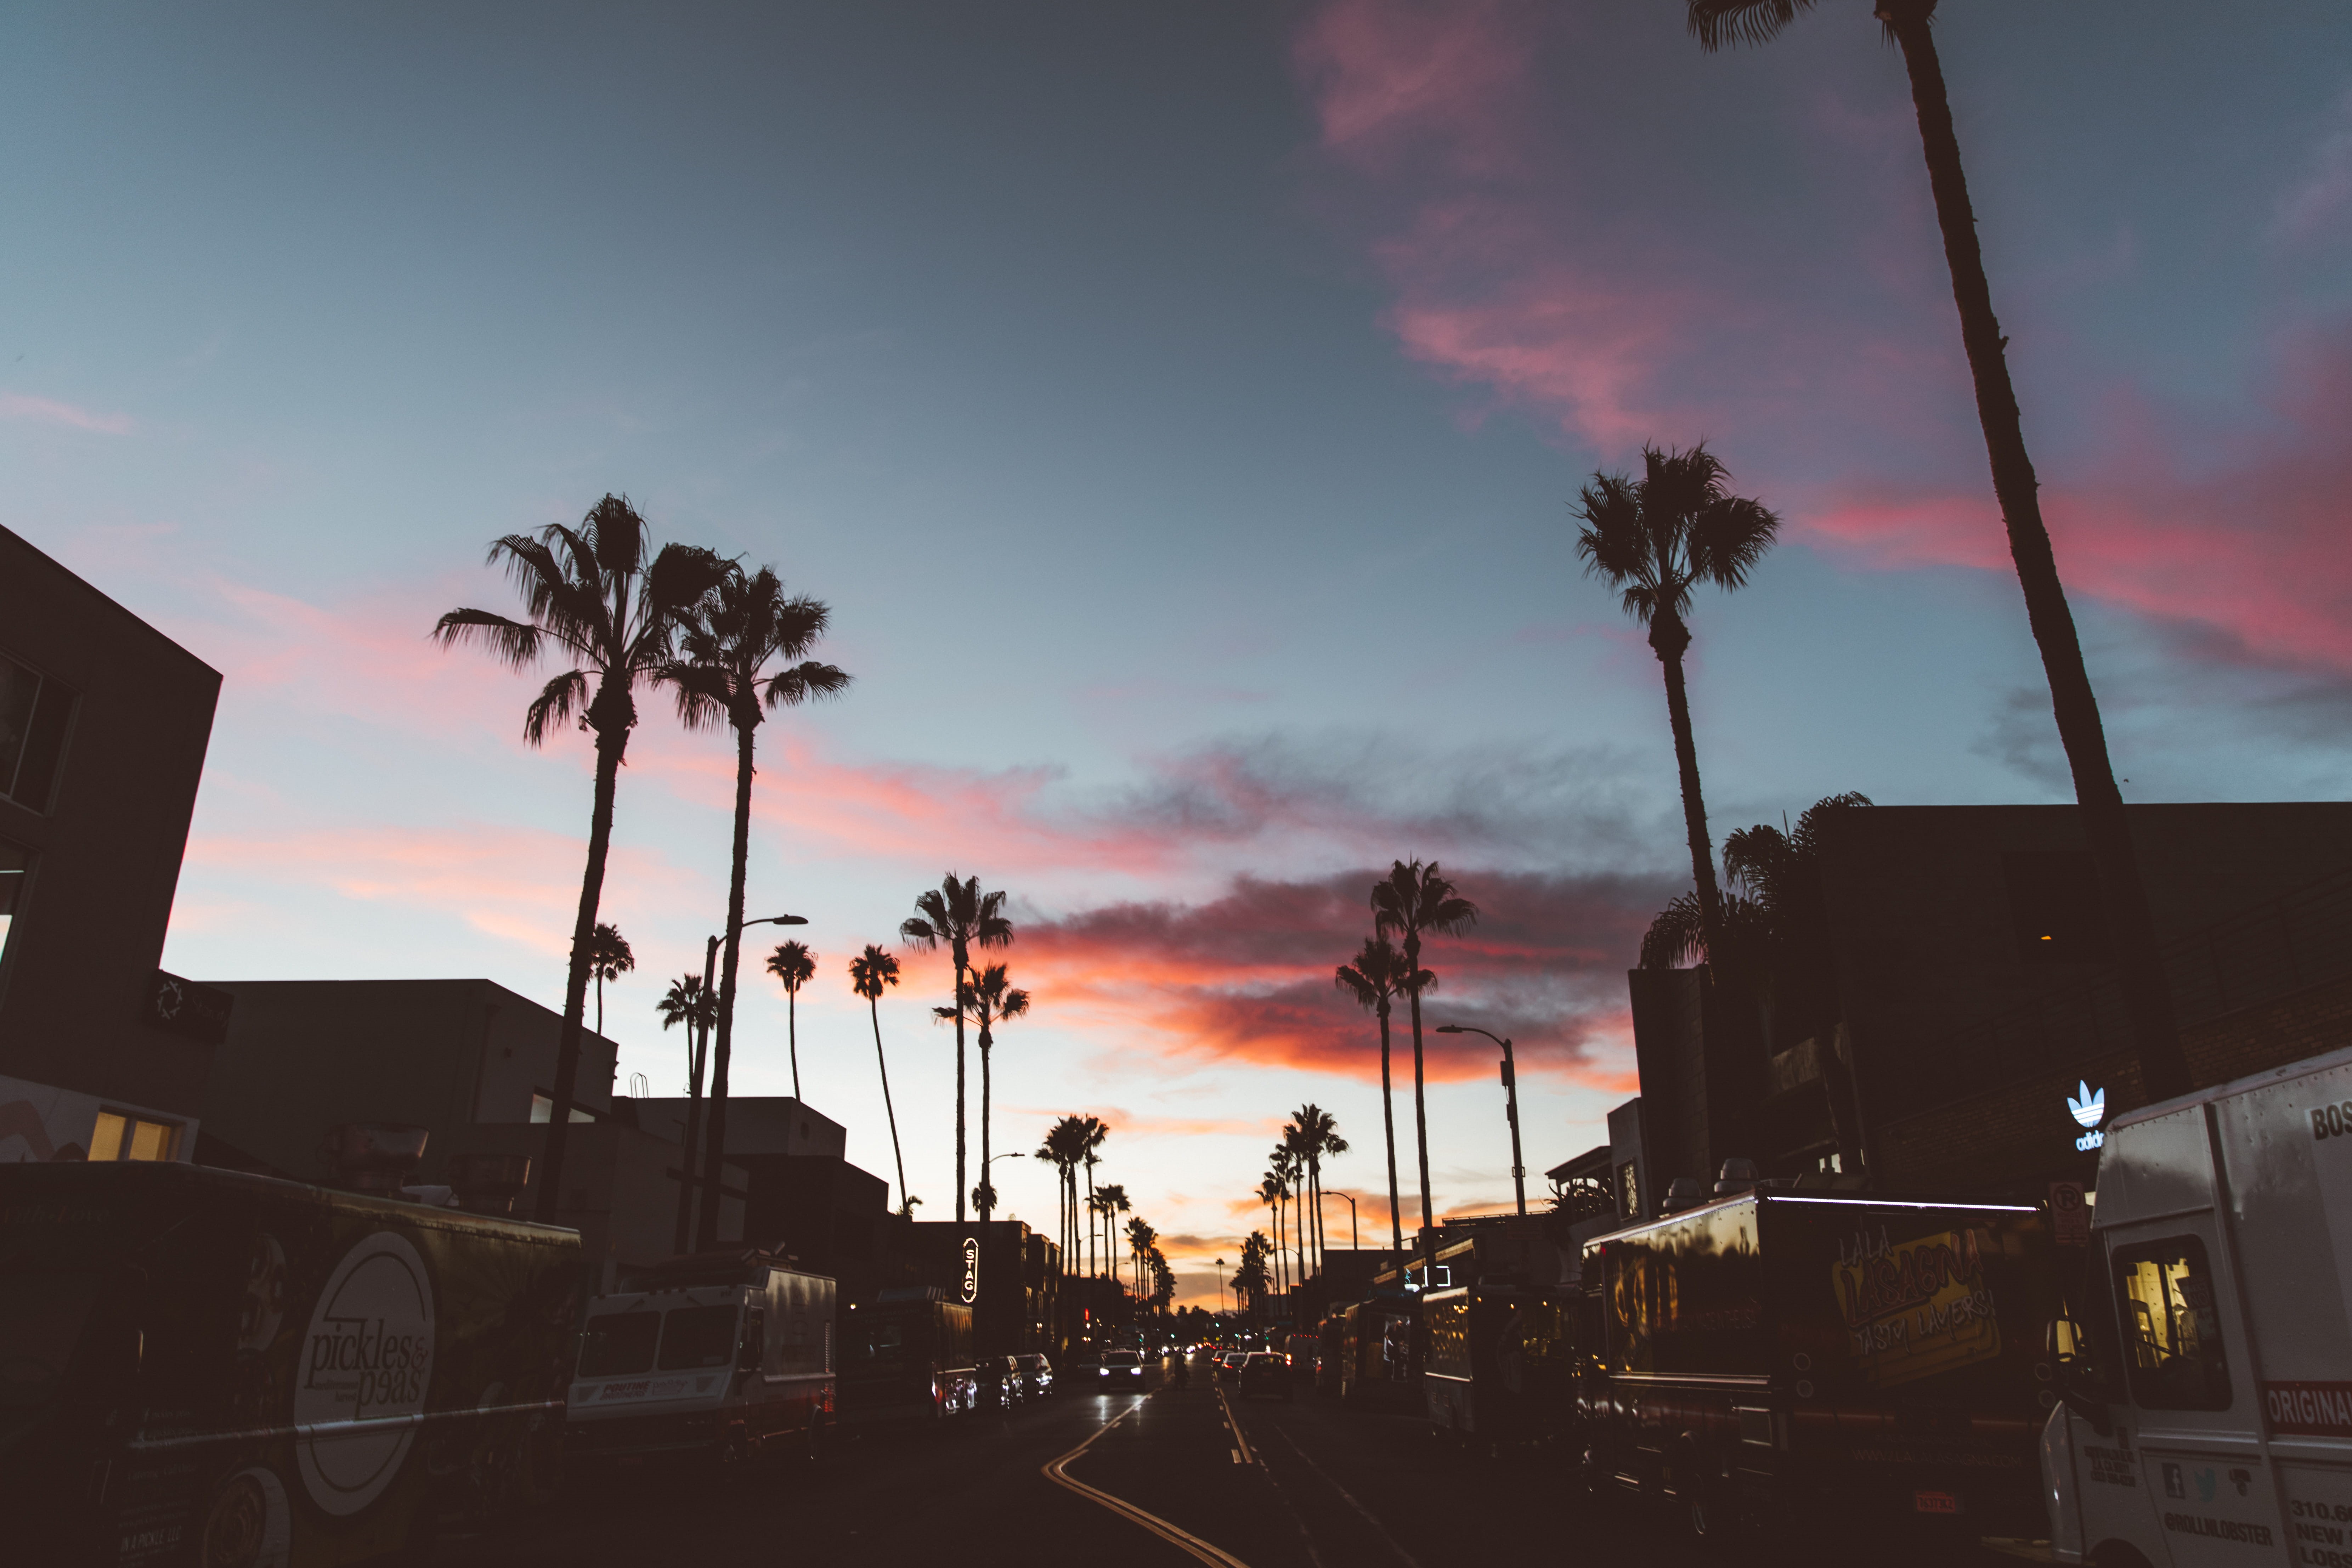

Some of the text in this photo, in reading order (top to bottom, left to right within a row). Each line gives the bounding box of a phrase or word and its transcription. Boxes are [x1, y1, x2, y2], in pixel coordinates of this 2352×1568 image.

[1838, 1224, 1893, 1267] LALA
[965, 1249, 975, 1290] STAG
[1841, 1228, 1984, 1329] LASAGNA
[1855, 1289, 1997, 1356] TASTY LAYERS!
[305, 1318, 412, 1389] pickles
[603, 1380, 651, 1393] POUTINE
[2164, 1512, 2274, 1547] @ROLLNLOBSTER
[2295, 1523, 2343, 1546] NEW
